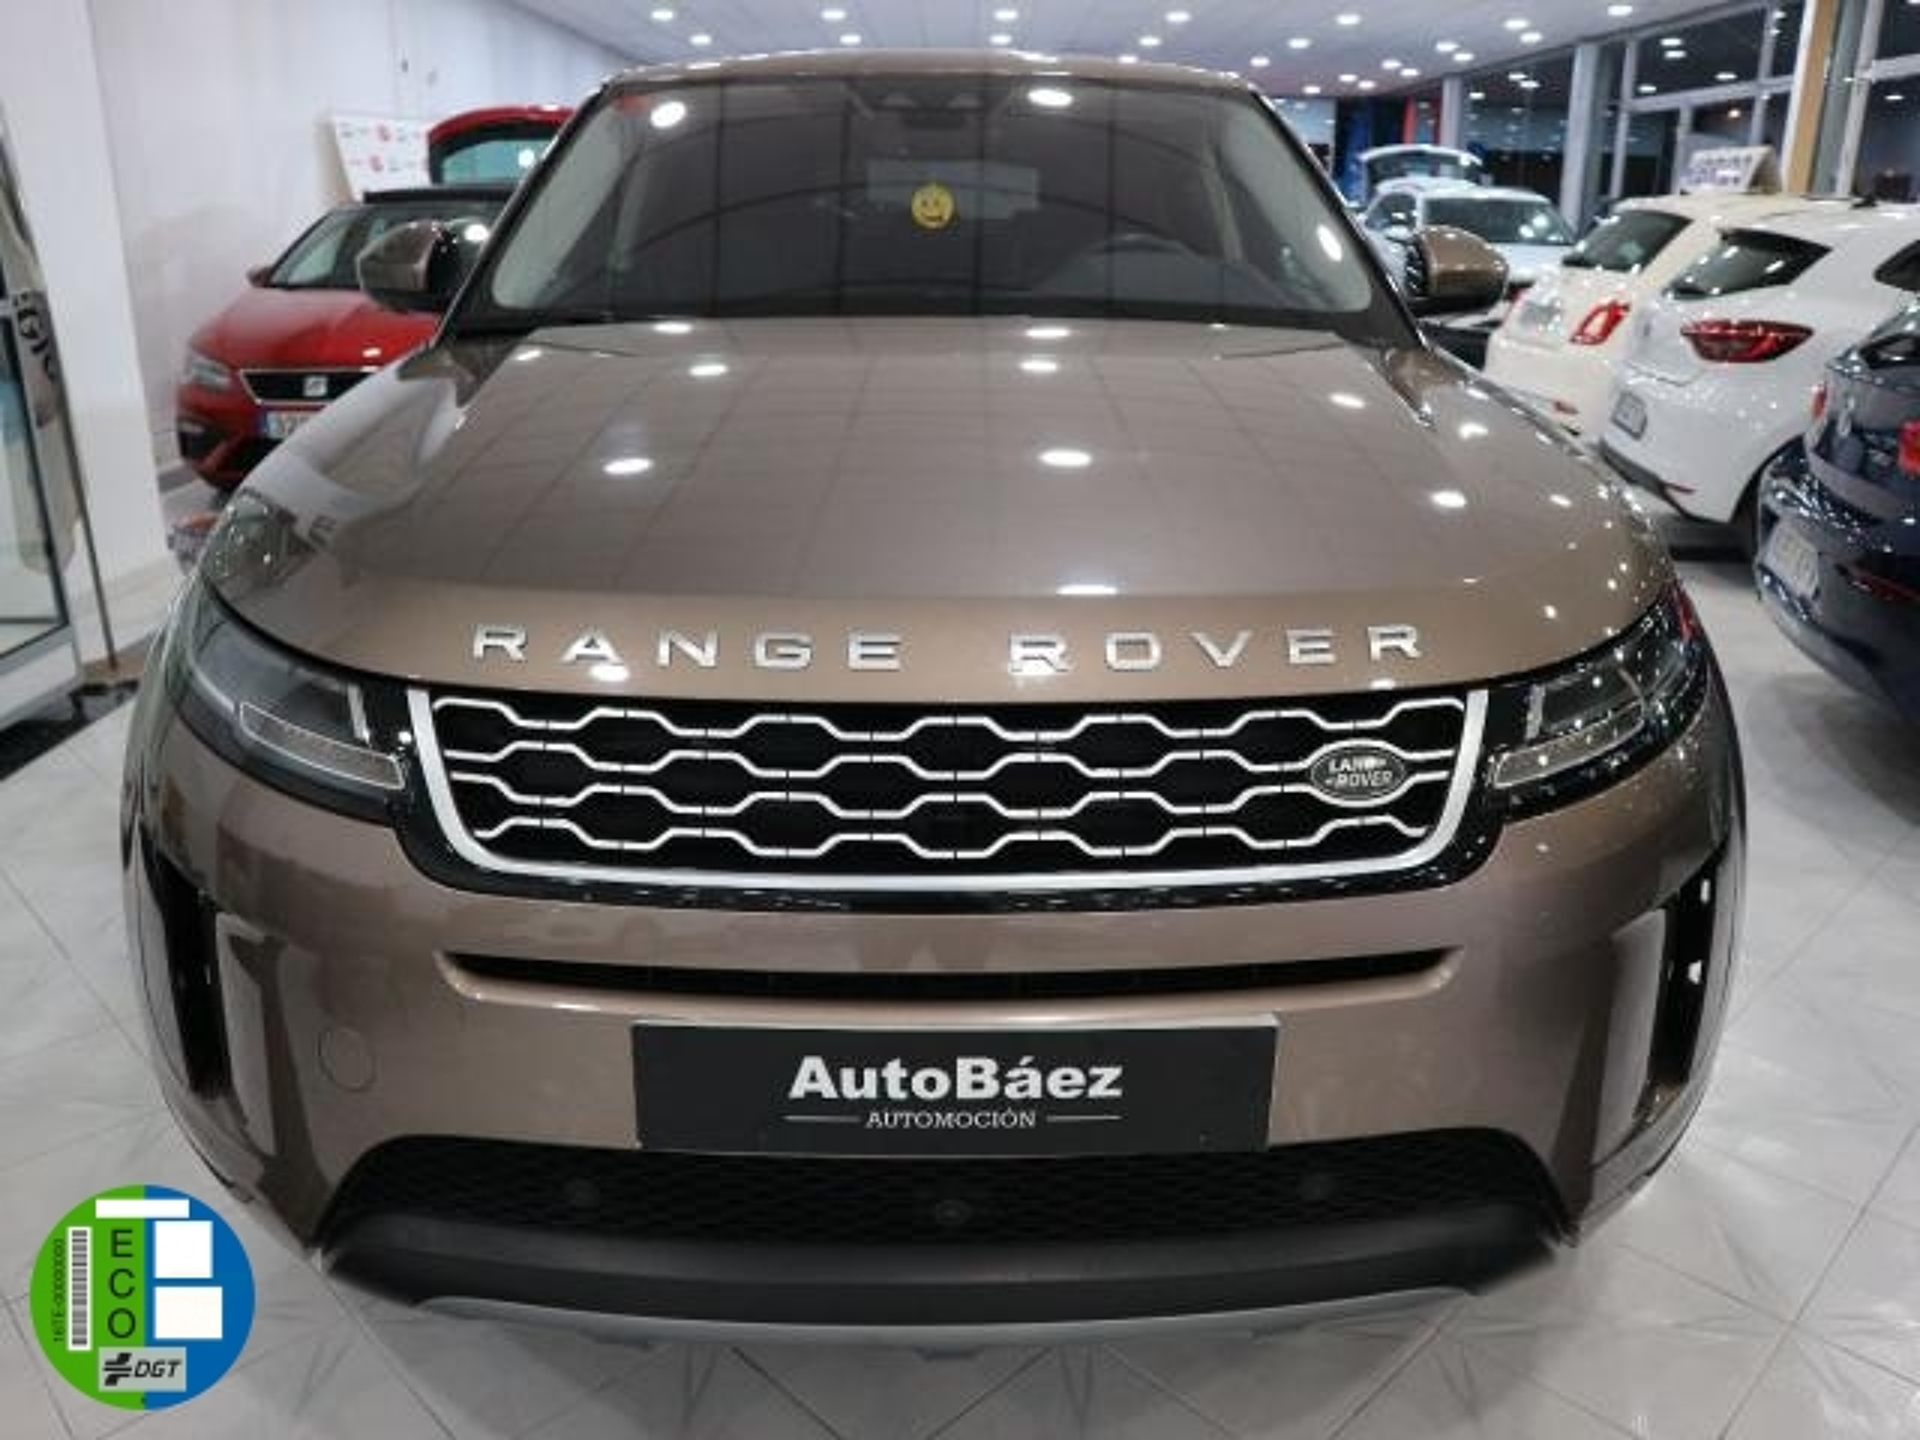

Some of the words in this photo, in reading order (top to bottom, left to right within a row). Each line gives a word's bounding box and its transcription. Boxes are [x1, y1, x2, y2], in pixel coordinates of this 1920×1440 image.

[472, 624, 901, 671] RANGE
[1008, 624, 1423, 675] ROVER
[1335, 770, 1393, 788] ROVER
[788, 1055, 1123, 1100] AutoBáez
[865, 1108, 1036, 1129] AUTOMOCIÓN
